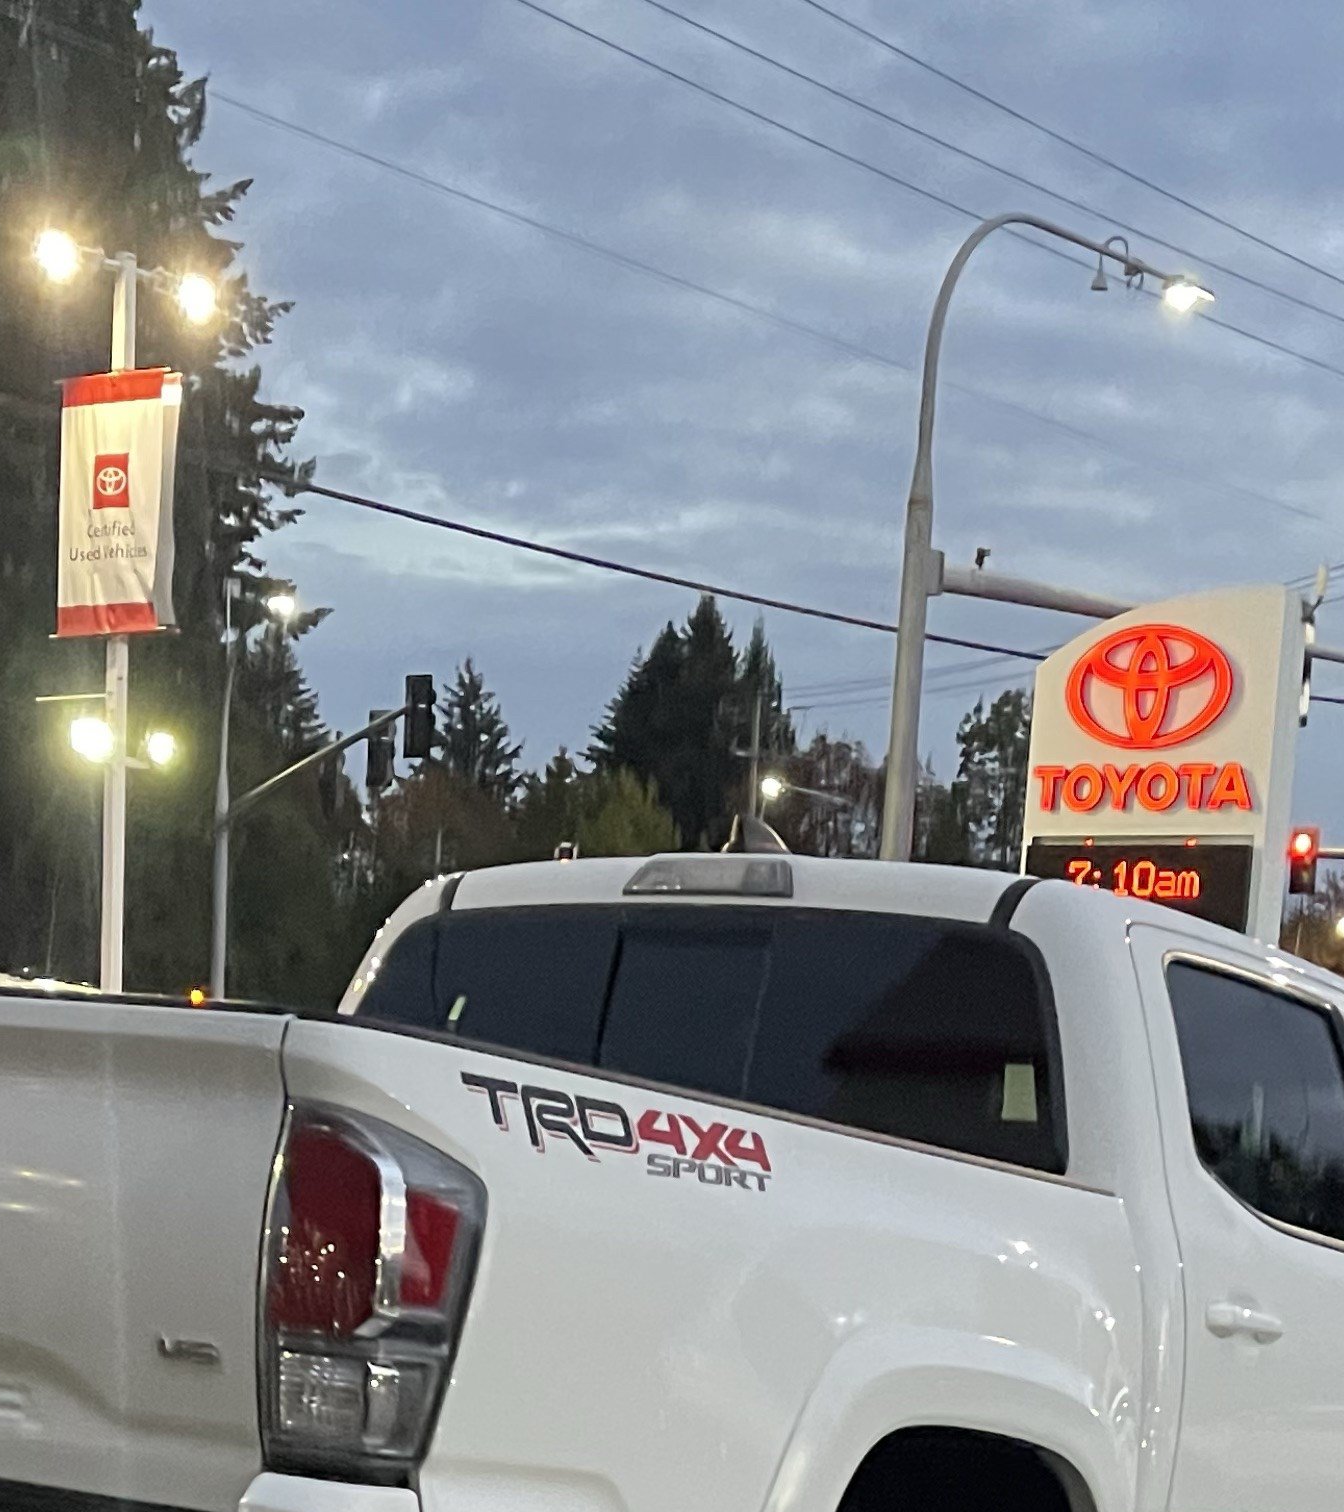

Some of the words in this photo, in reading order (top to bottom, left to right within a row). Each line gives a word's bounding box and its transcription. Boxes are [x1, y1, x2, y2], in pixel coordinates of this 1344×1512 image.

[87, 520, 135, 538] Certified
[69, 545, 101, 562] Used
[1034, 762, 1253, 813] TOYOTA
[1067, 860, 1201, 899] 7:10am
[460, 1071, 641, 1163] TRD
[646, 1153, 772, 1192] SPORT
